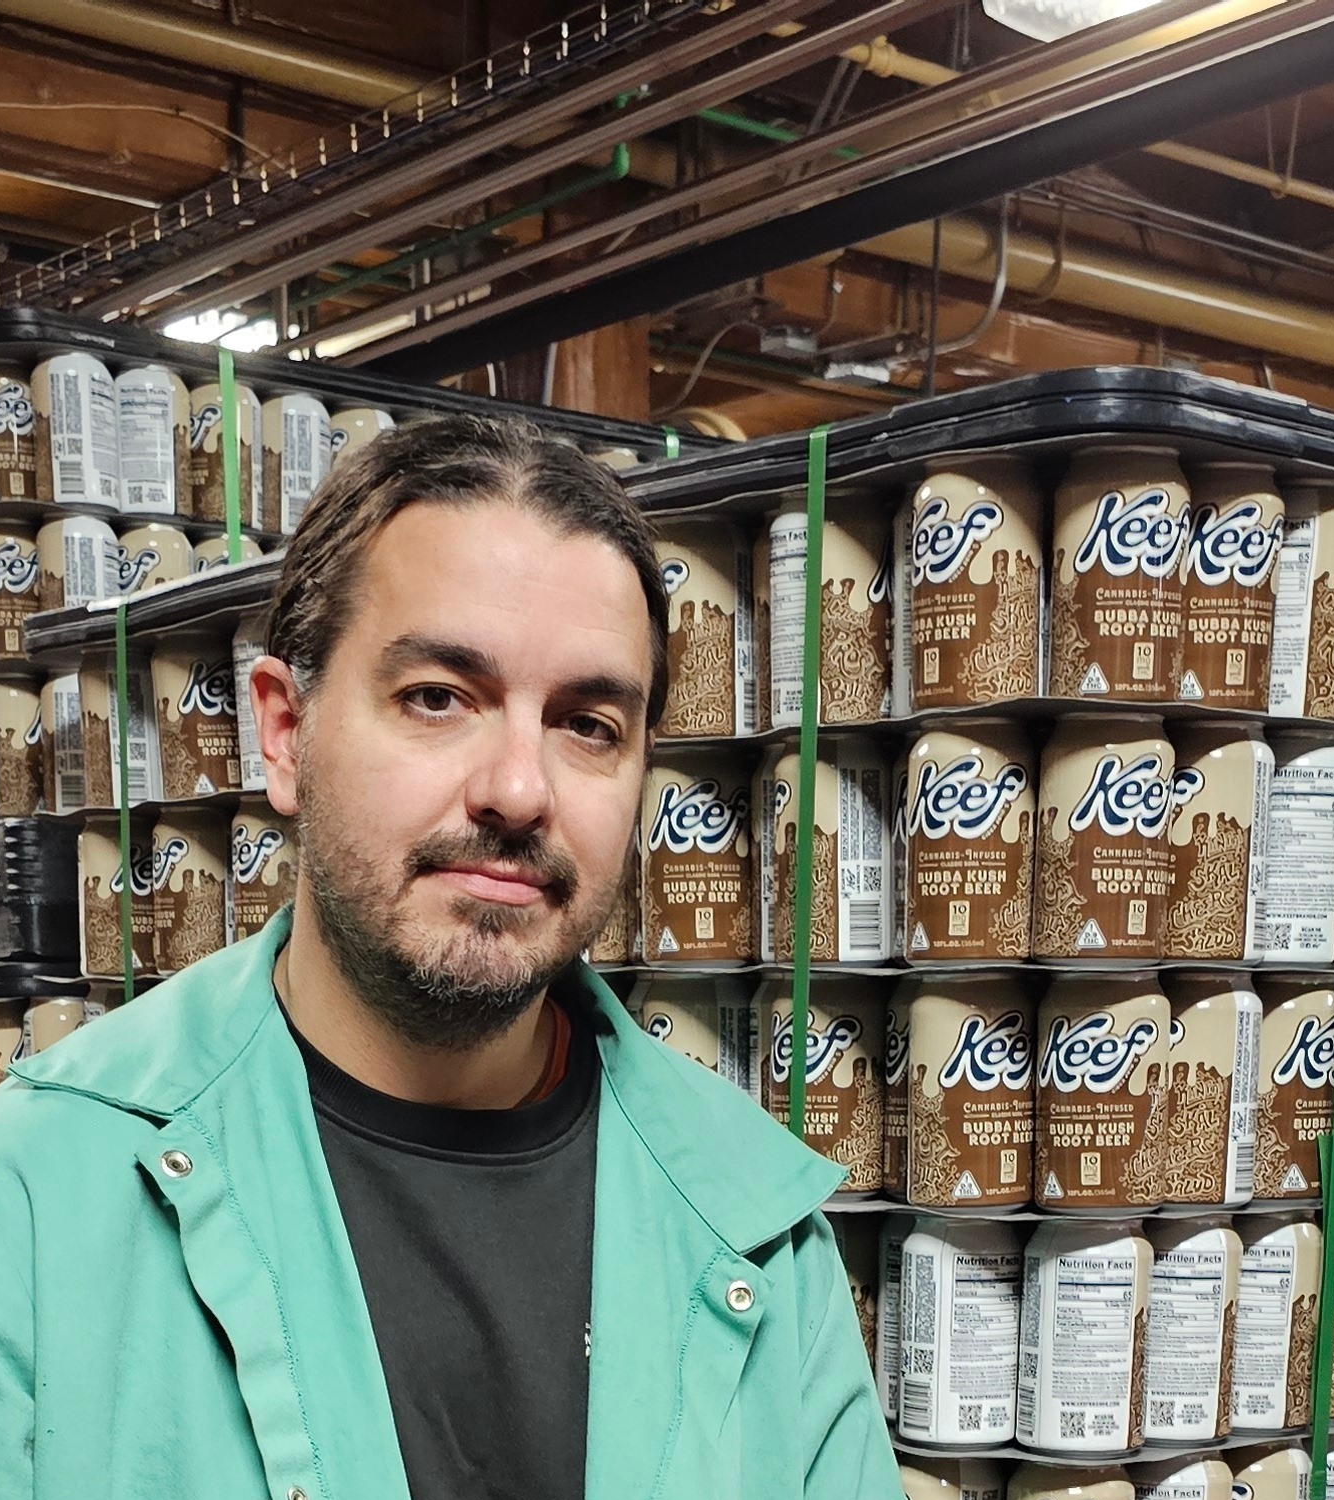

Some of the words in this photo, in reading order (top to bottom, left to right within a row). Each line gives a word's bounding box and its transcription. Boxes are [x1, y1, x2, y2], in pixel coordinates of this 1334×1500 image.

[1094, 609, 1149, 624] BUBBA
[1153, 610, 1182, 626] KUSH
[1100, 623, 1146, 636] ROOT
[1151, 624, 1178, 638] BEER
[1188, 618, 1240, 631] BUBBA
[1193, 630, 1237, 644] ROOT
[1241, 631, 1268, 645] BEER
[1137, 646, 1151, 657] 10
[1229, 652, 1243, 663] 10
[197, 738, 234, 747] BUBBA
[202, 747, 232, 756] ROOT
[909, 754, 1027, 839] Keef
[648, 779, 750, 854] Keef
[917, 870, 963, 883] BUBBA
[967, 870, 1007, 883] KUSH
[1091, 868, 1143, 881] BUBBA
[663, 881, 707, 893] BUBBA
[710, 881, 741, 892] KUSH
[921, 882, 960, 896] ROOT
[964, 882, 1001, 895] BEER
[1097, 881, 1141, 894] ROOT
[668, 892, 705, 904] ROOT
[708, 892, 738, 903] BEER
[698, 911, 711, 919] 10
[953, 905, 966, 913] 10
[1132, 903, 1145, 914] 10
[1039, 1011, 1158, 1093] Keef
[963, 1121, 1012, 1134] BUBBA
[1049, 1123, 1094, 1135] BUBBA
[1098, 1122, 1135, 1135] KUSH
[969, 1133, 1010, 1146] ROOT
[1053, 1135, 1091, 1148] ROOT
[1096, 1134, 1131, 1147] BEER
[1003, 1153, 1015, 1162] 10
[1084, 1157, 1098, 1165] 10
[955, 1253, 1000, 1267] Nutrition
[1059, 1259, 1104, 1269] Nutrition
[1107, 1259, 1133, 1270] Facts
[1196, 1252, 1223, 1265] Facts
[1211, 1283, 1223, 1294] 65
[1123, 1291, 1132, 1301] 65
[1172, 1487, 1202, 1499] Facts
